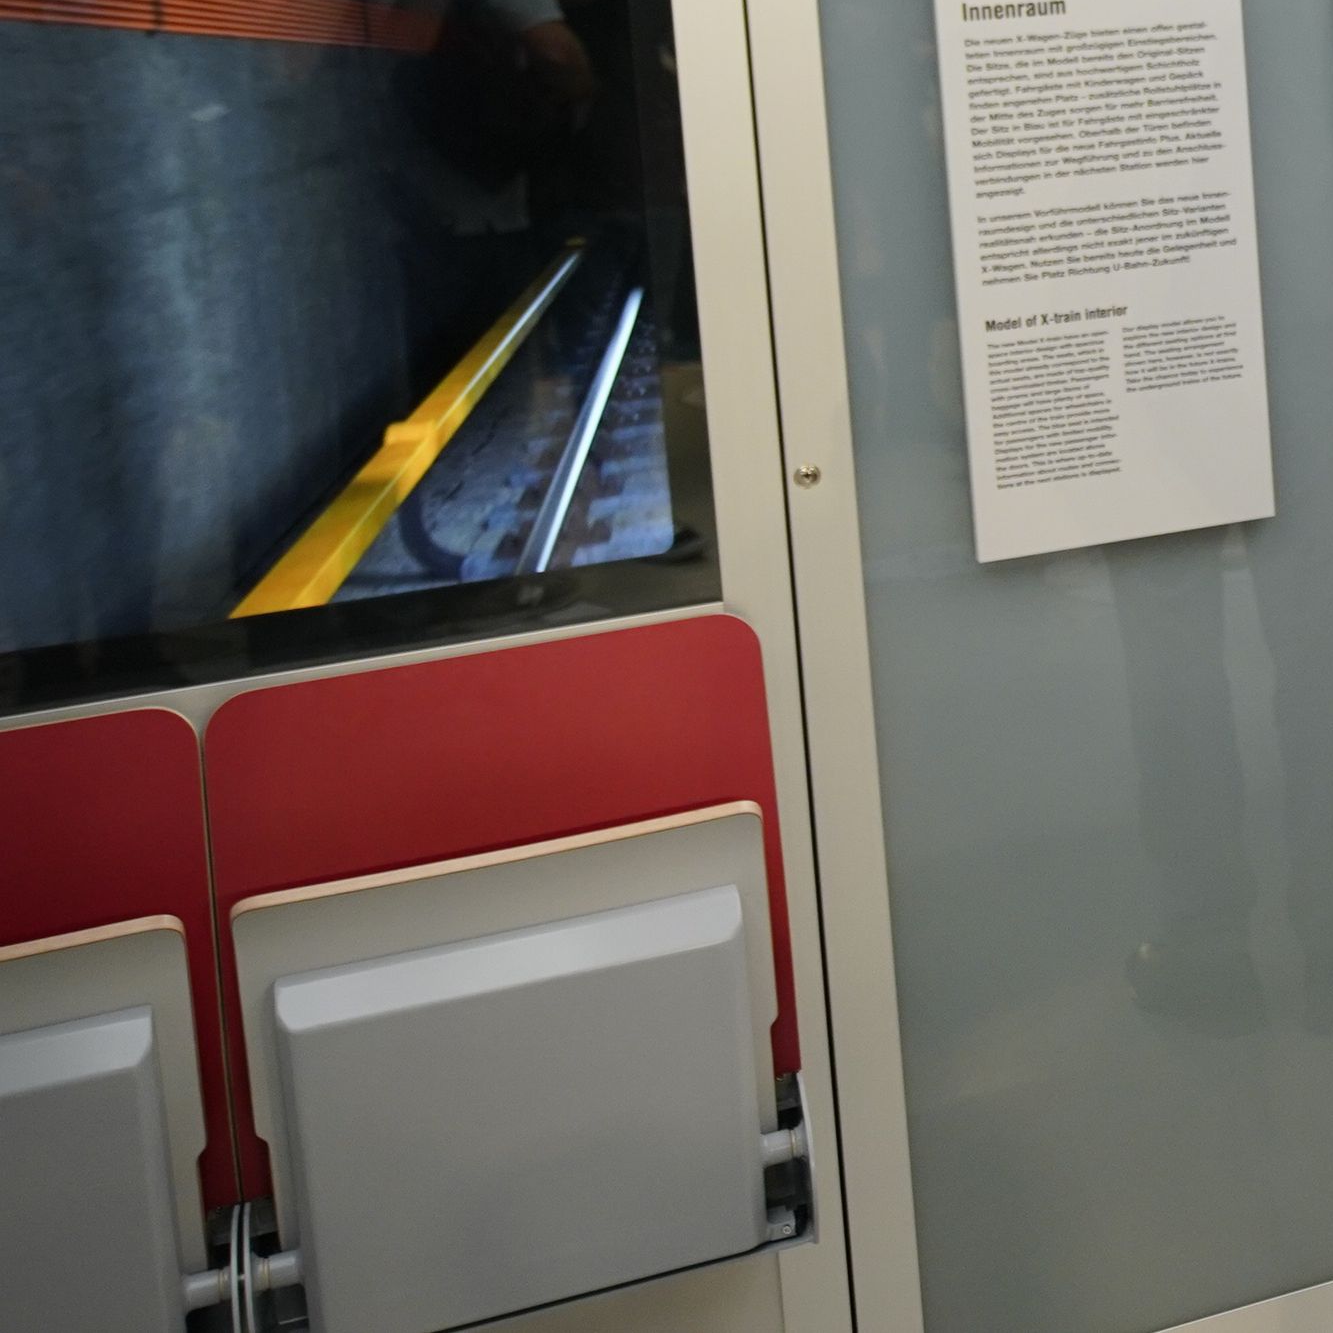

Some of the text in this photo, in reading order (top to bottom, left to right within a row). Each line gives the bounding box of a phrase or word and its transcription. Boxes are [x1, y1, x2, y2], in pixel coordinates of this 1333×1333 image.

[985, 305, 1129, 333] Model of X-train interior
